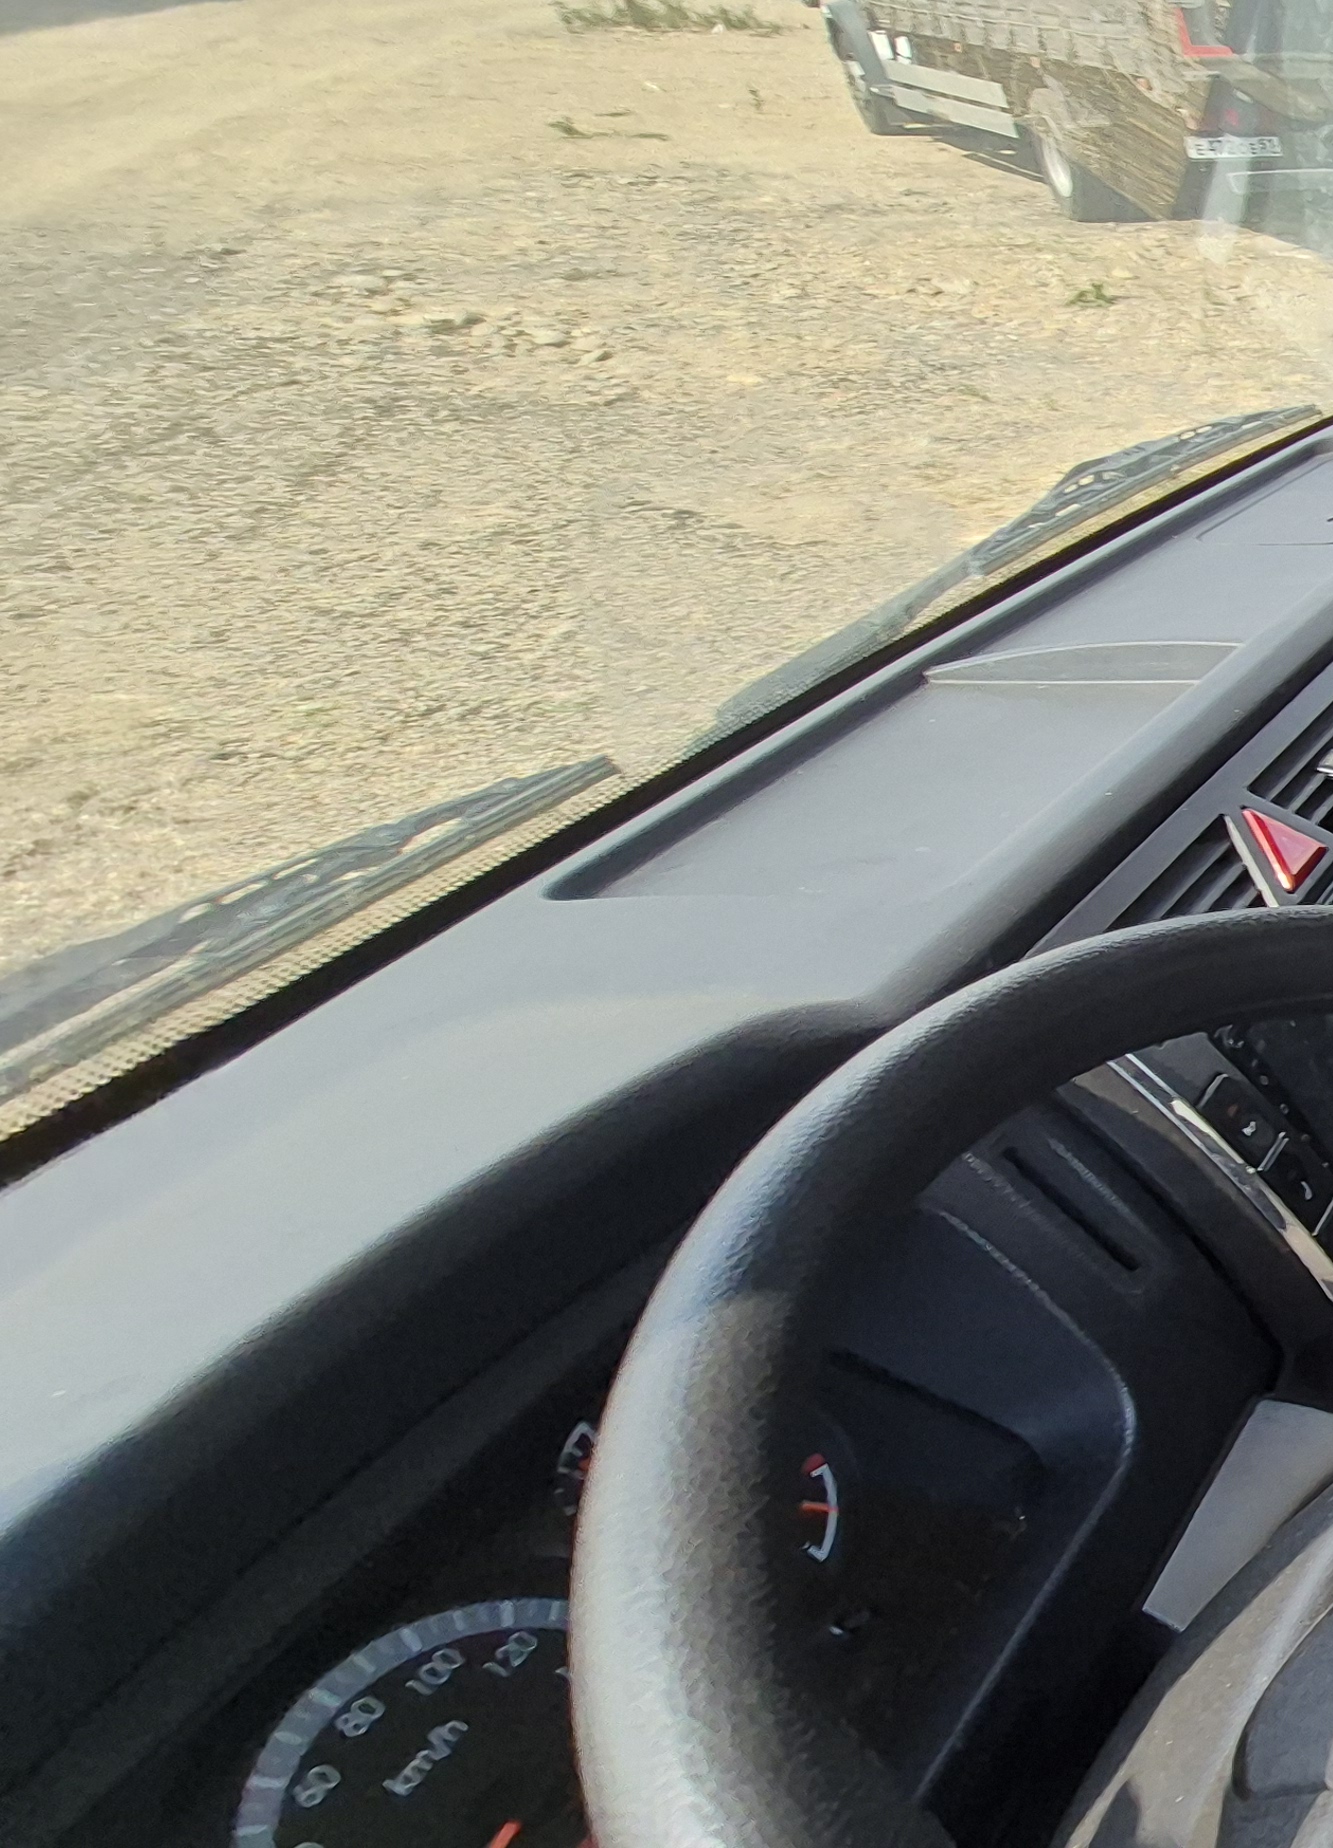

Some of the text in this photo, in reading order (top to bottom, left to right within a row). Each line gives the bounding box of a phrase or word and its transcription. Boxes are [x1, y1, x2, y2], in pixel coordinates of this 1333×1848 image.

[405, 1648, 465, 1696] 100
[482, 1631, 538, 1677] 120
[335, 1696, 386, 1737] 80
[382, 1720, 469, 1796] km/h
[293, 1764, 341, 1808] 60
